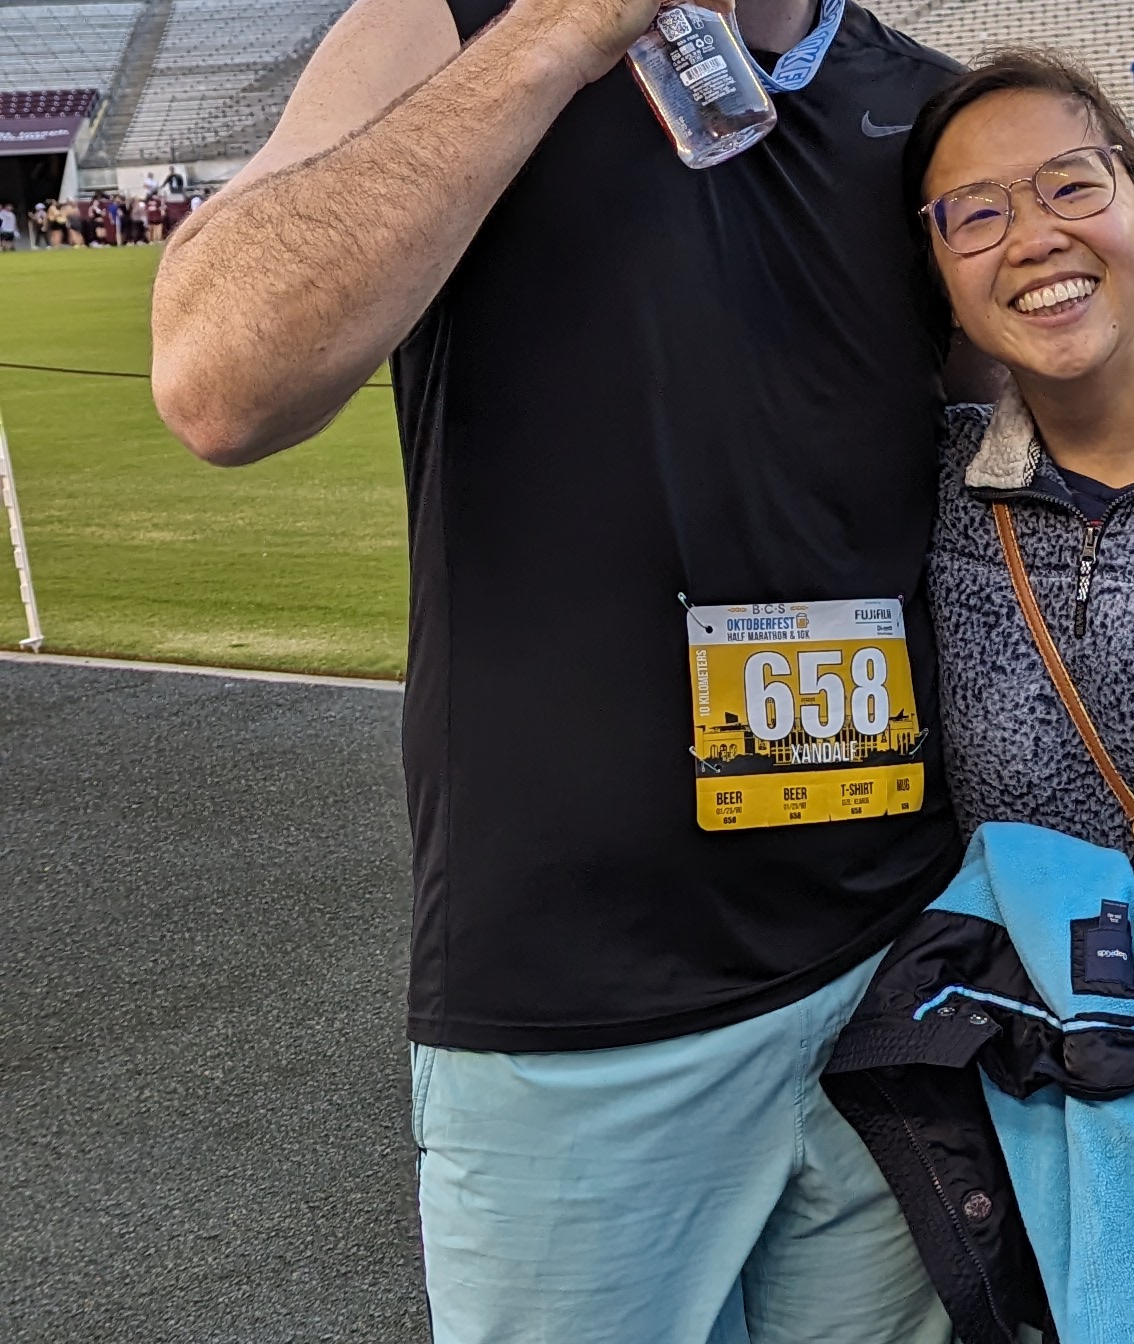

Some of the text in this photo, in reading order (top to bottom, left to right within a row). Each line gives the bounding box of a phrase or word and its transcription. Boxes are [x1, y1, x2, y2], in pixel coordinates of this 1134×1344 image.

[727, 617, 795, 632] OKTOBERFEST
[727, 631, 745, 642] HALF
[748, 631, 787, 641] MARATHON
[797, 630, 811, 640] 10K
[696, 649, 710, 717] 10 KILOMETERS
[744, 647, 890, 741] 658
[790, 740, 858, 765] XANDALF
[783, 787, 807, 801] BEER
[841, 781, 874, 797] T-SHIRT
[716, 791, 742, 806] BEER
[723, 816, 737, 825] 658
[789, 812, 802, 820] 658
